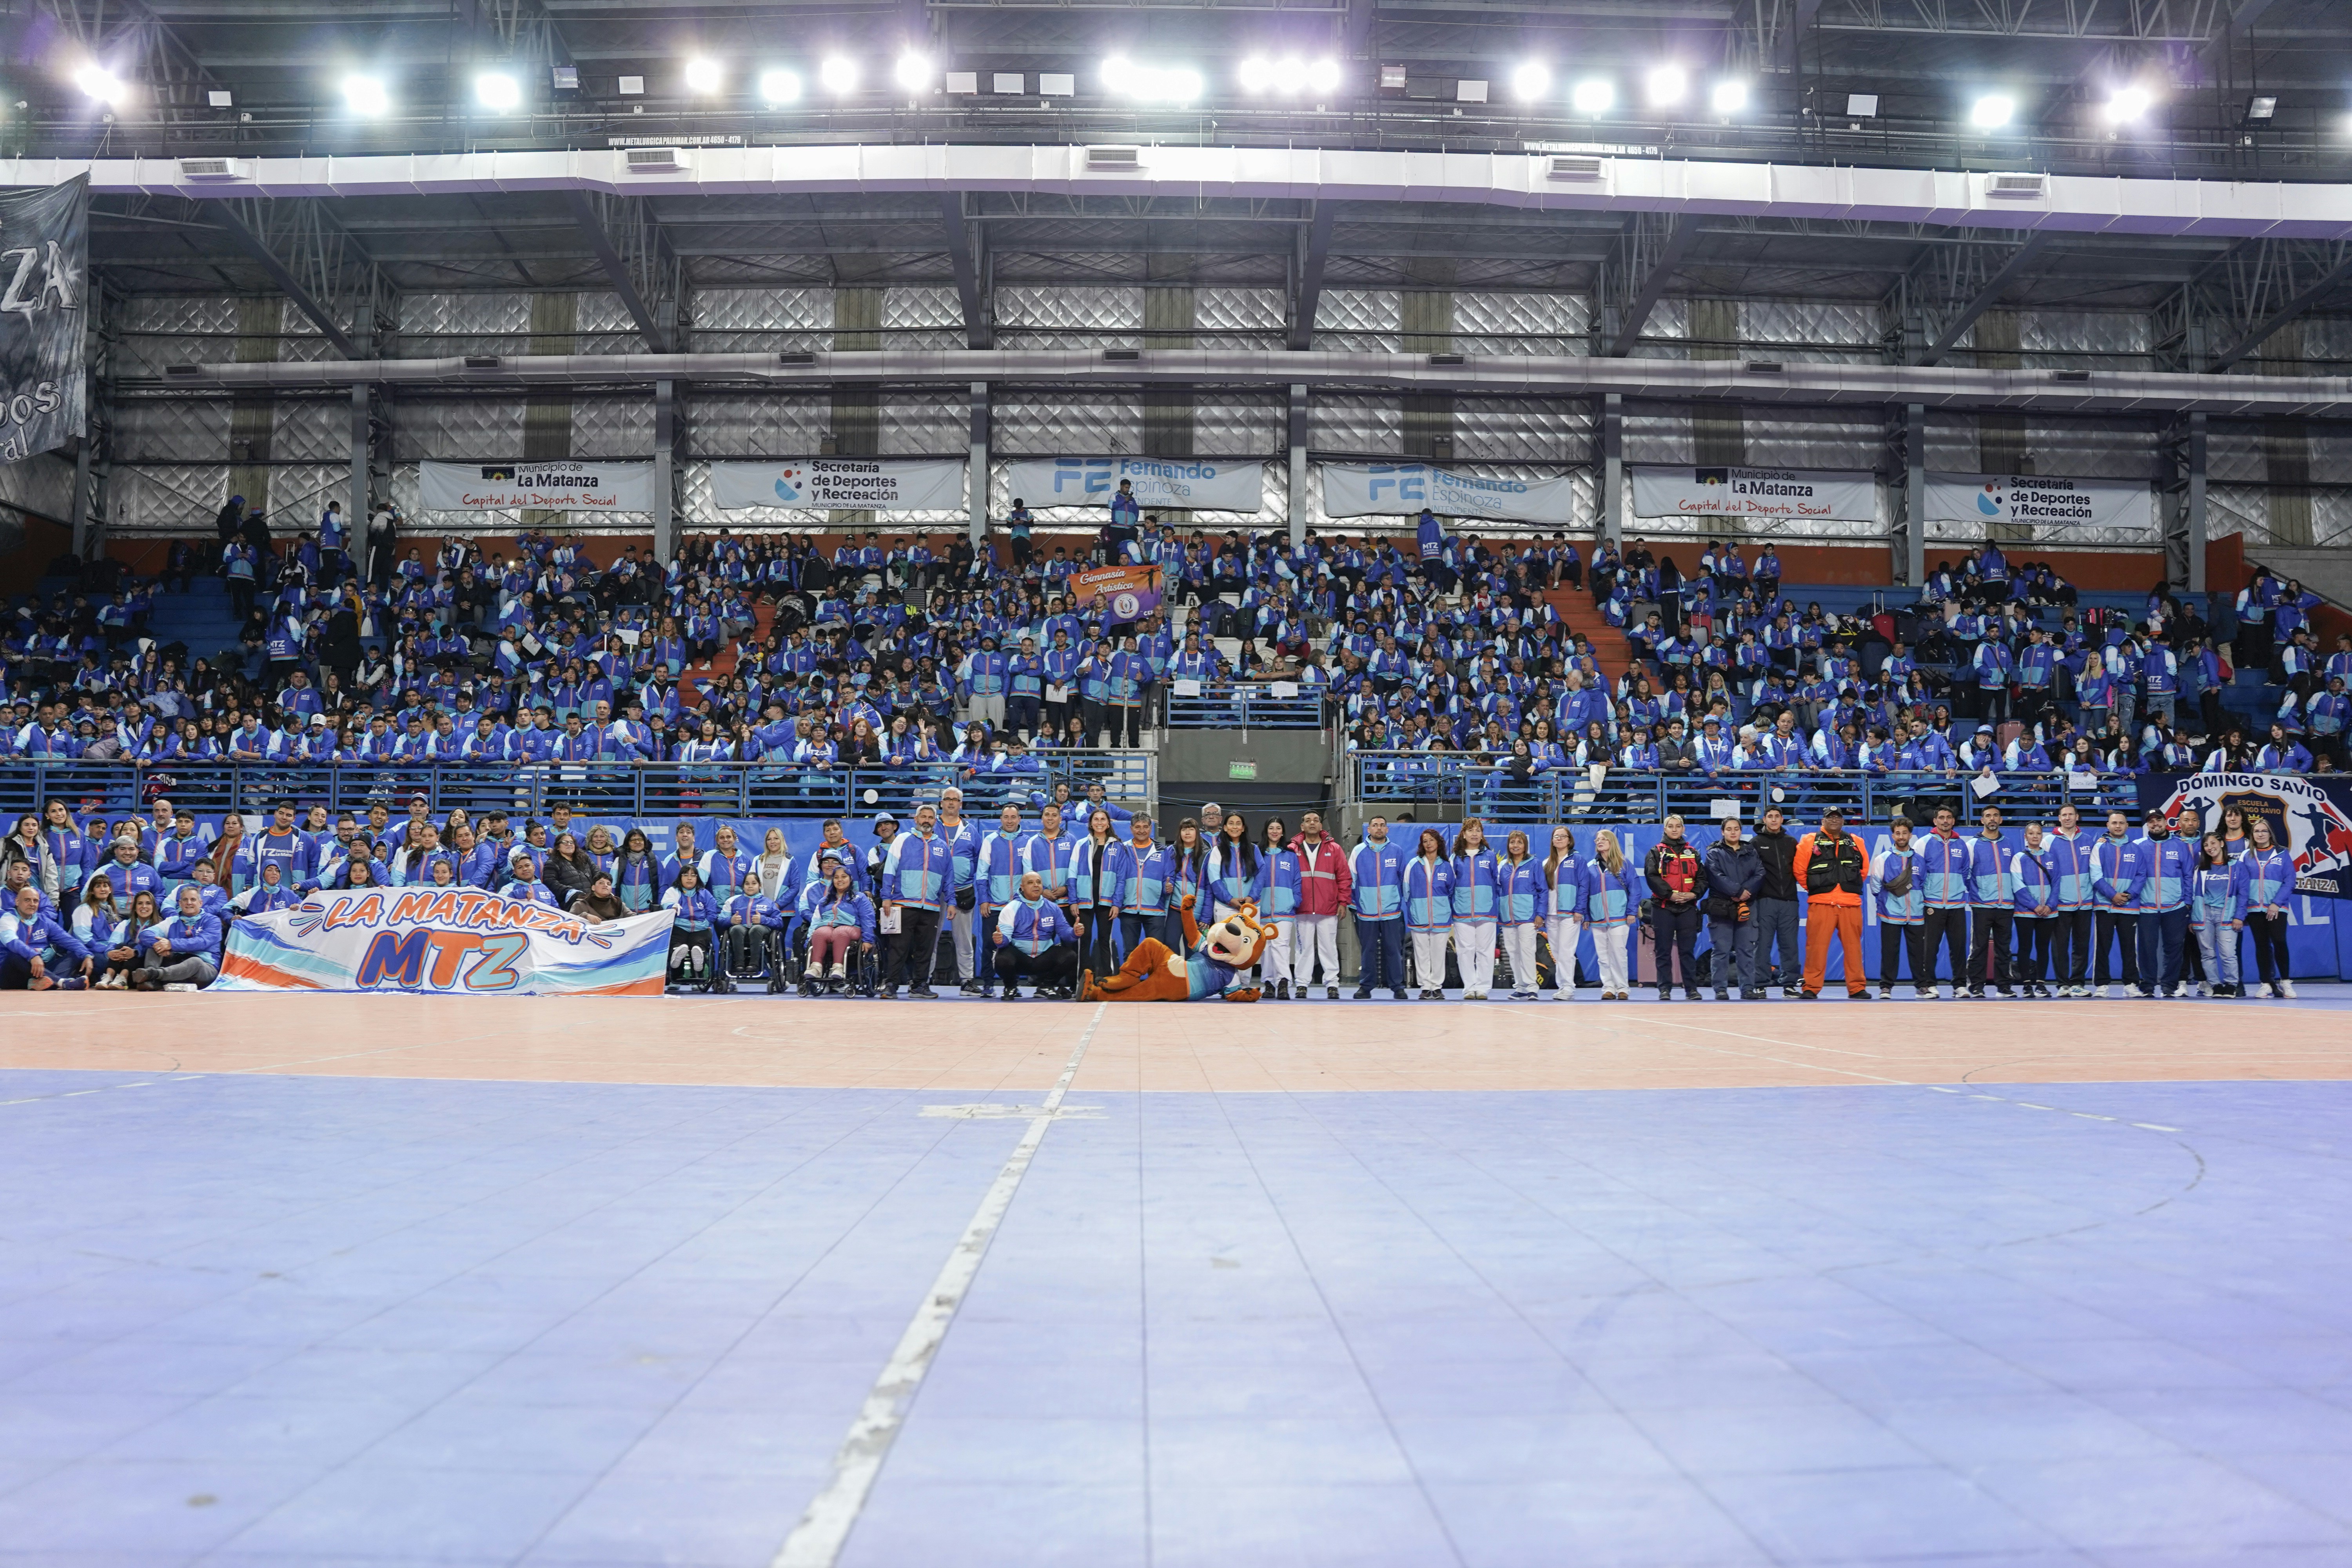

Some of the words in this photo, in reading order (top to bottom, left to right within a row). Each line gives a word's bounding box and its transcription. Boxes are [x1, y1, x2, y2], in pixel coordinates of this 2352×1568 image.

[608, 136, 710, 145] WWW.METALURGICAPALOMAR.COM.AR
[728, 136, 741, 144] 4179
[1627, 146, 1642, 154] 4650
[1645, 146, 1658, 154] 4179
[518, 462, 567, 473] Municipio
[569, 462, 583, 472] de
[812, 461, 879, 473] Secretaría
[1120, 458, 1216, 480] Fernando
[517, 474, 533, 487] La
[537, 474, 598, 488] Matanza
[811, 475, 830, 486] de
[833, 475, 897, 489] Deportes
[1054, 458, 1112, 493] FE
[1433, 469, 1527, 494] Fernando
[1731, 469, 1778, 481] Municipio
[1779, 471, 1795, 481] de
[1732, 480, 1746, 494] La
[1750, 481, 1813, 497] Matanza
[2011, 477, 2074, 490] Secretaría
[462, 493, 505, 506] Capital
[510, 494, 527, 505] del
[531, 493, 577, 508] Deporte
[583, 494, 616, 506] Social
[811, 489, 820, 502] y
[822, 488, 898, 501] Recreación
[1134, 497, 1172, 506] ENDENTE
[1433, 486, 1502, 509] Espinoza
[2011, 491, 2028, 503] de
[2031, 491, 2090, 506] Deportes
[1432, 506, 1484, 516] INTENDENTE
[1679, 499, 1720, 514] Capital
[1726, 500, 1741, 512] del
[1746, 500, 1793, 516] Deporte
[1798, 503, 1831, 514] Social
[2011, 506, 2018, 517] y
[2022, 505, 2092, 518] Recreación
[1080, 569, 1126, 584] Gimnasia
[1094, 581, 1134, 595] Artistica
[2180, 775, 2263, 793] DOMINGO
[2270, 778, 2326, 802] SAVIO
[262, 848, 276, 856] TZ
[2296, 877, 2339, 893] TANZA
[322, 893, 385, 932] LA
[386, 890, 587, 946] MATANZA
[357, 927, 528, 991] MTZ
